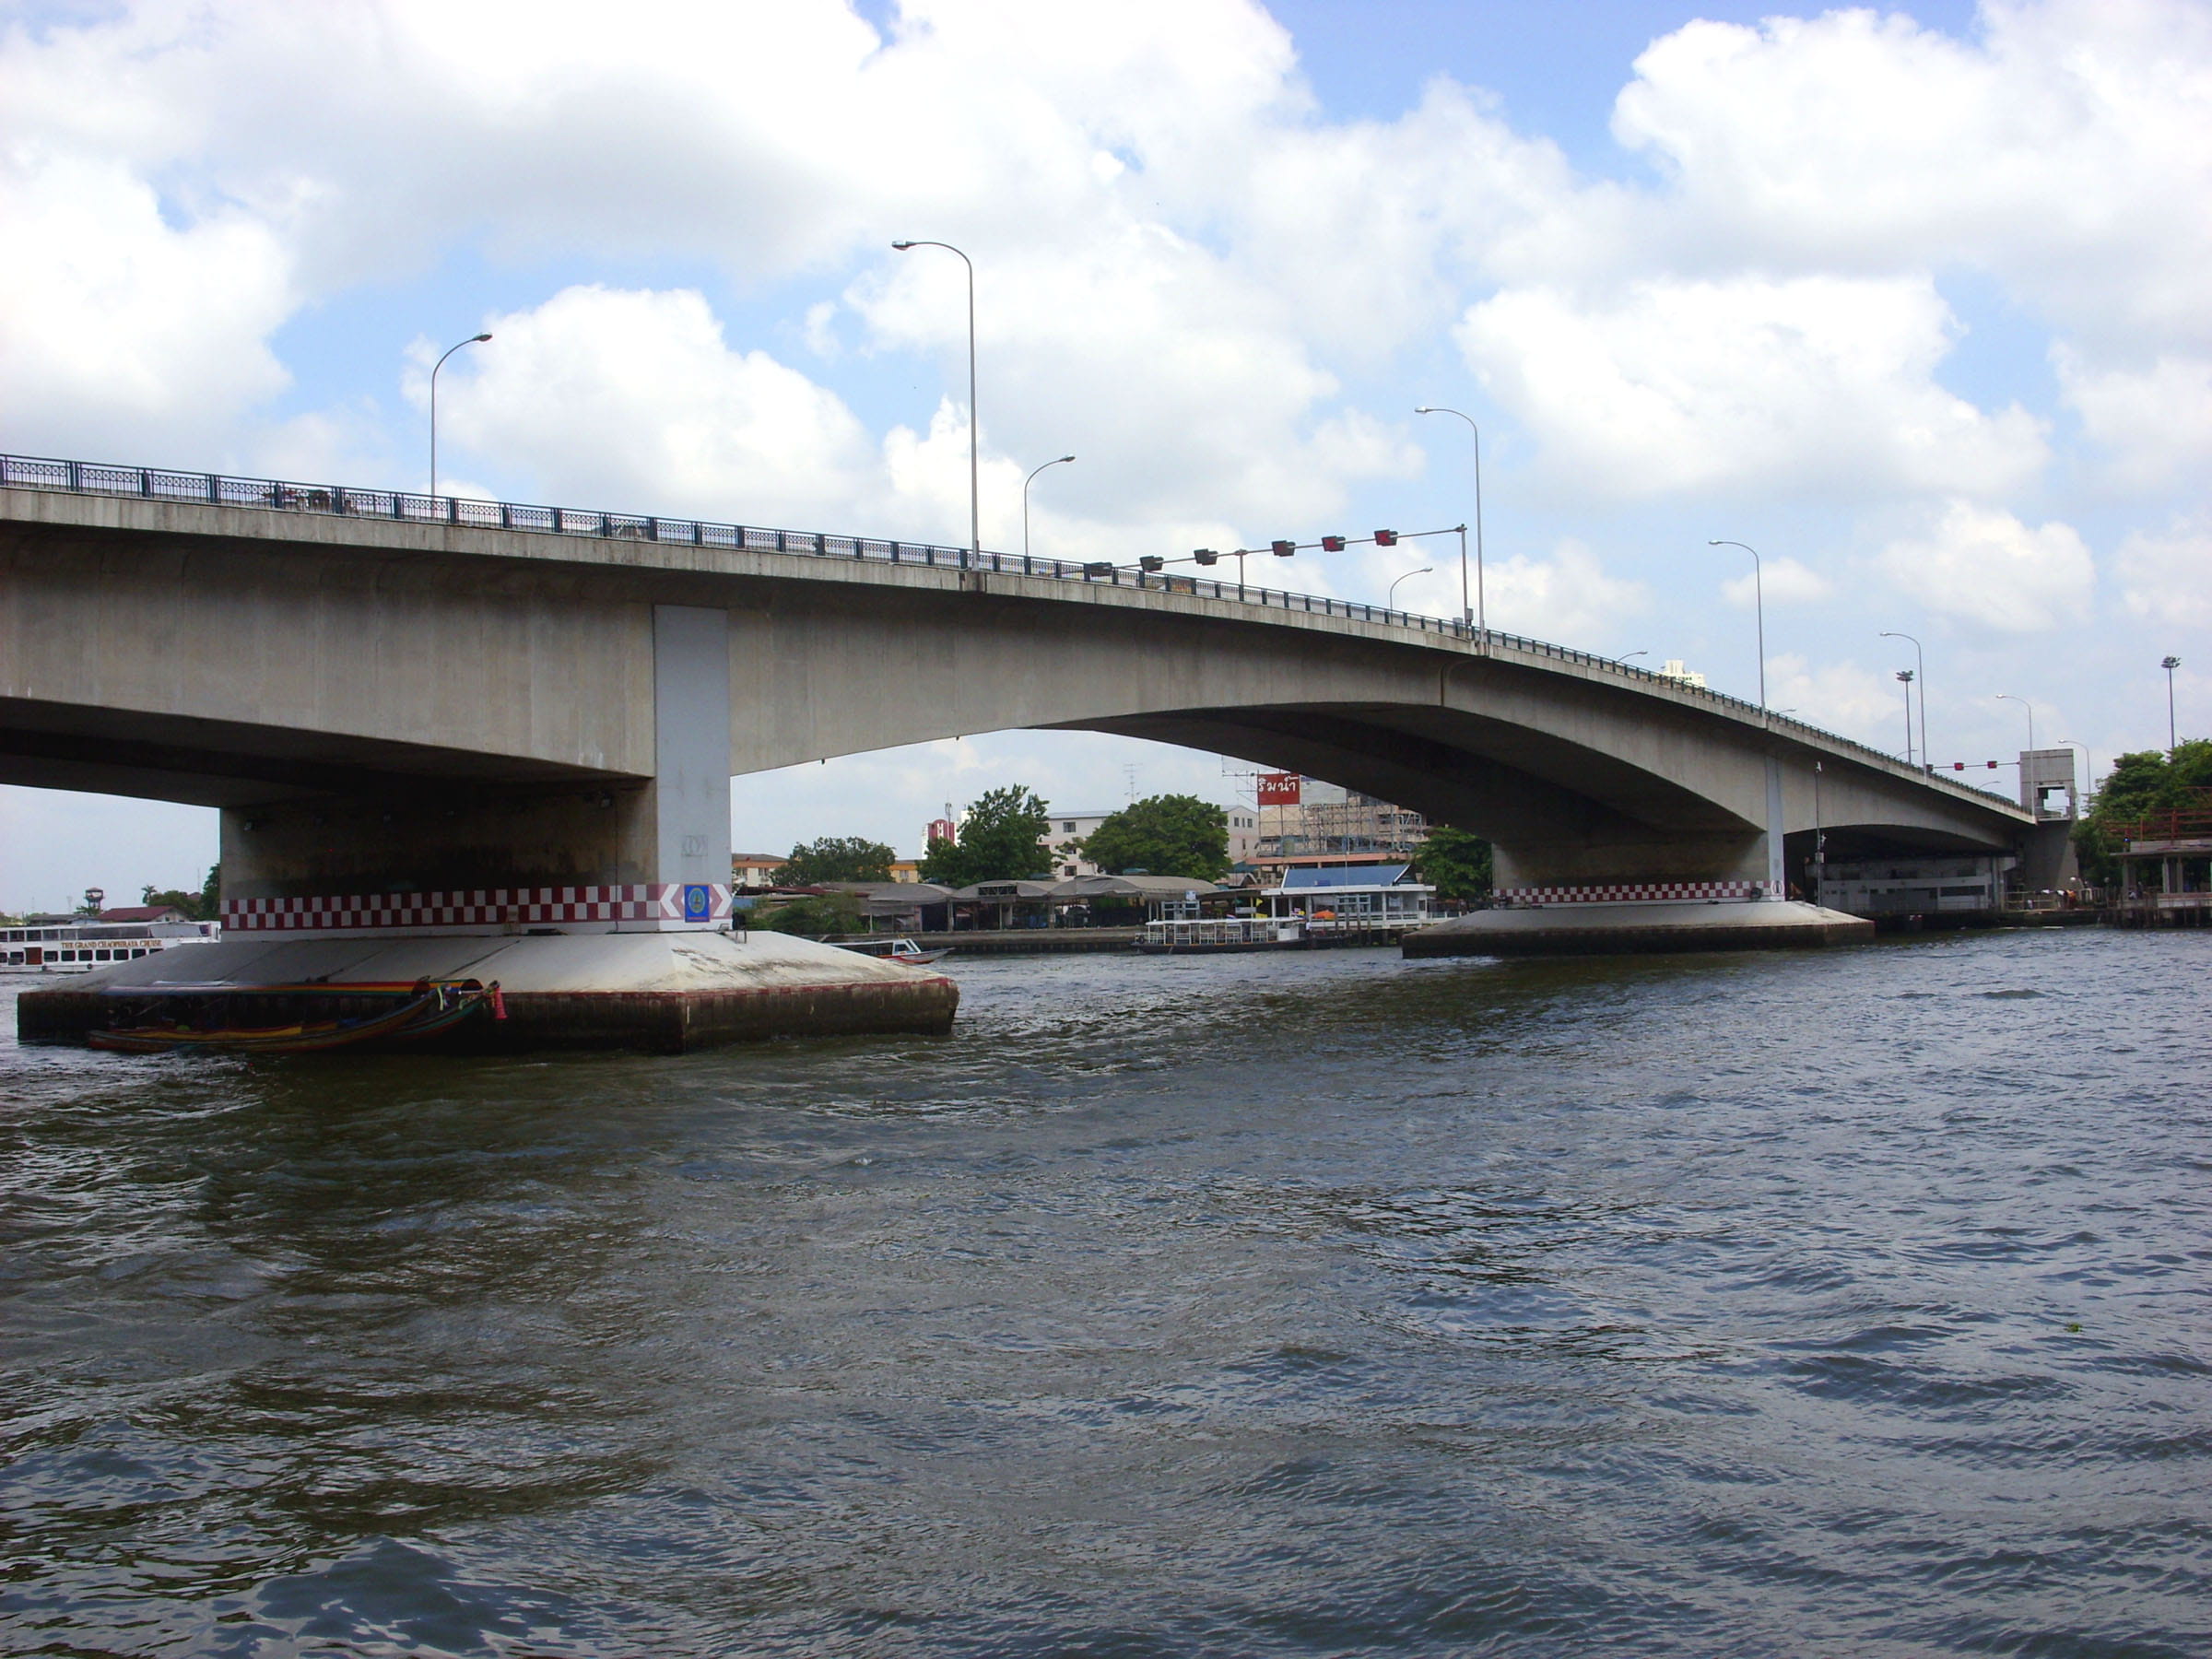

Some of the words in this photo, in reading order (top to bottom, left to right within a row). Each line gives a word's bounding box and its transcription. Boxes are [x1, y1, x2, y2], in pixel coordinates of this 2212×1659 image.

[1258, 776, 1299, 792] ริมน้ำ
[75, 941, 97, 949] GRAND
[140, 939, 162, 947] CRUISE
